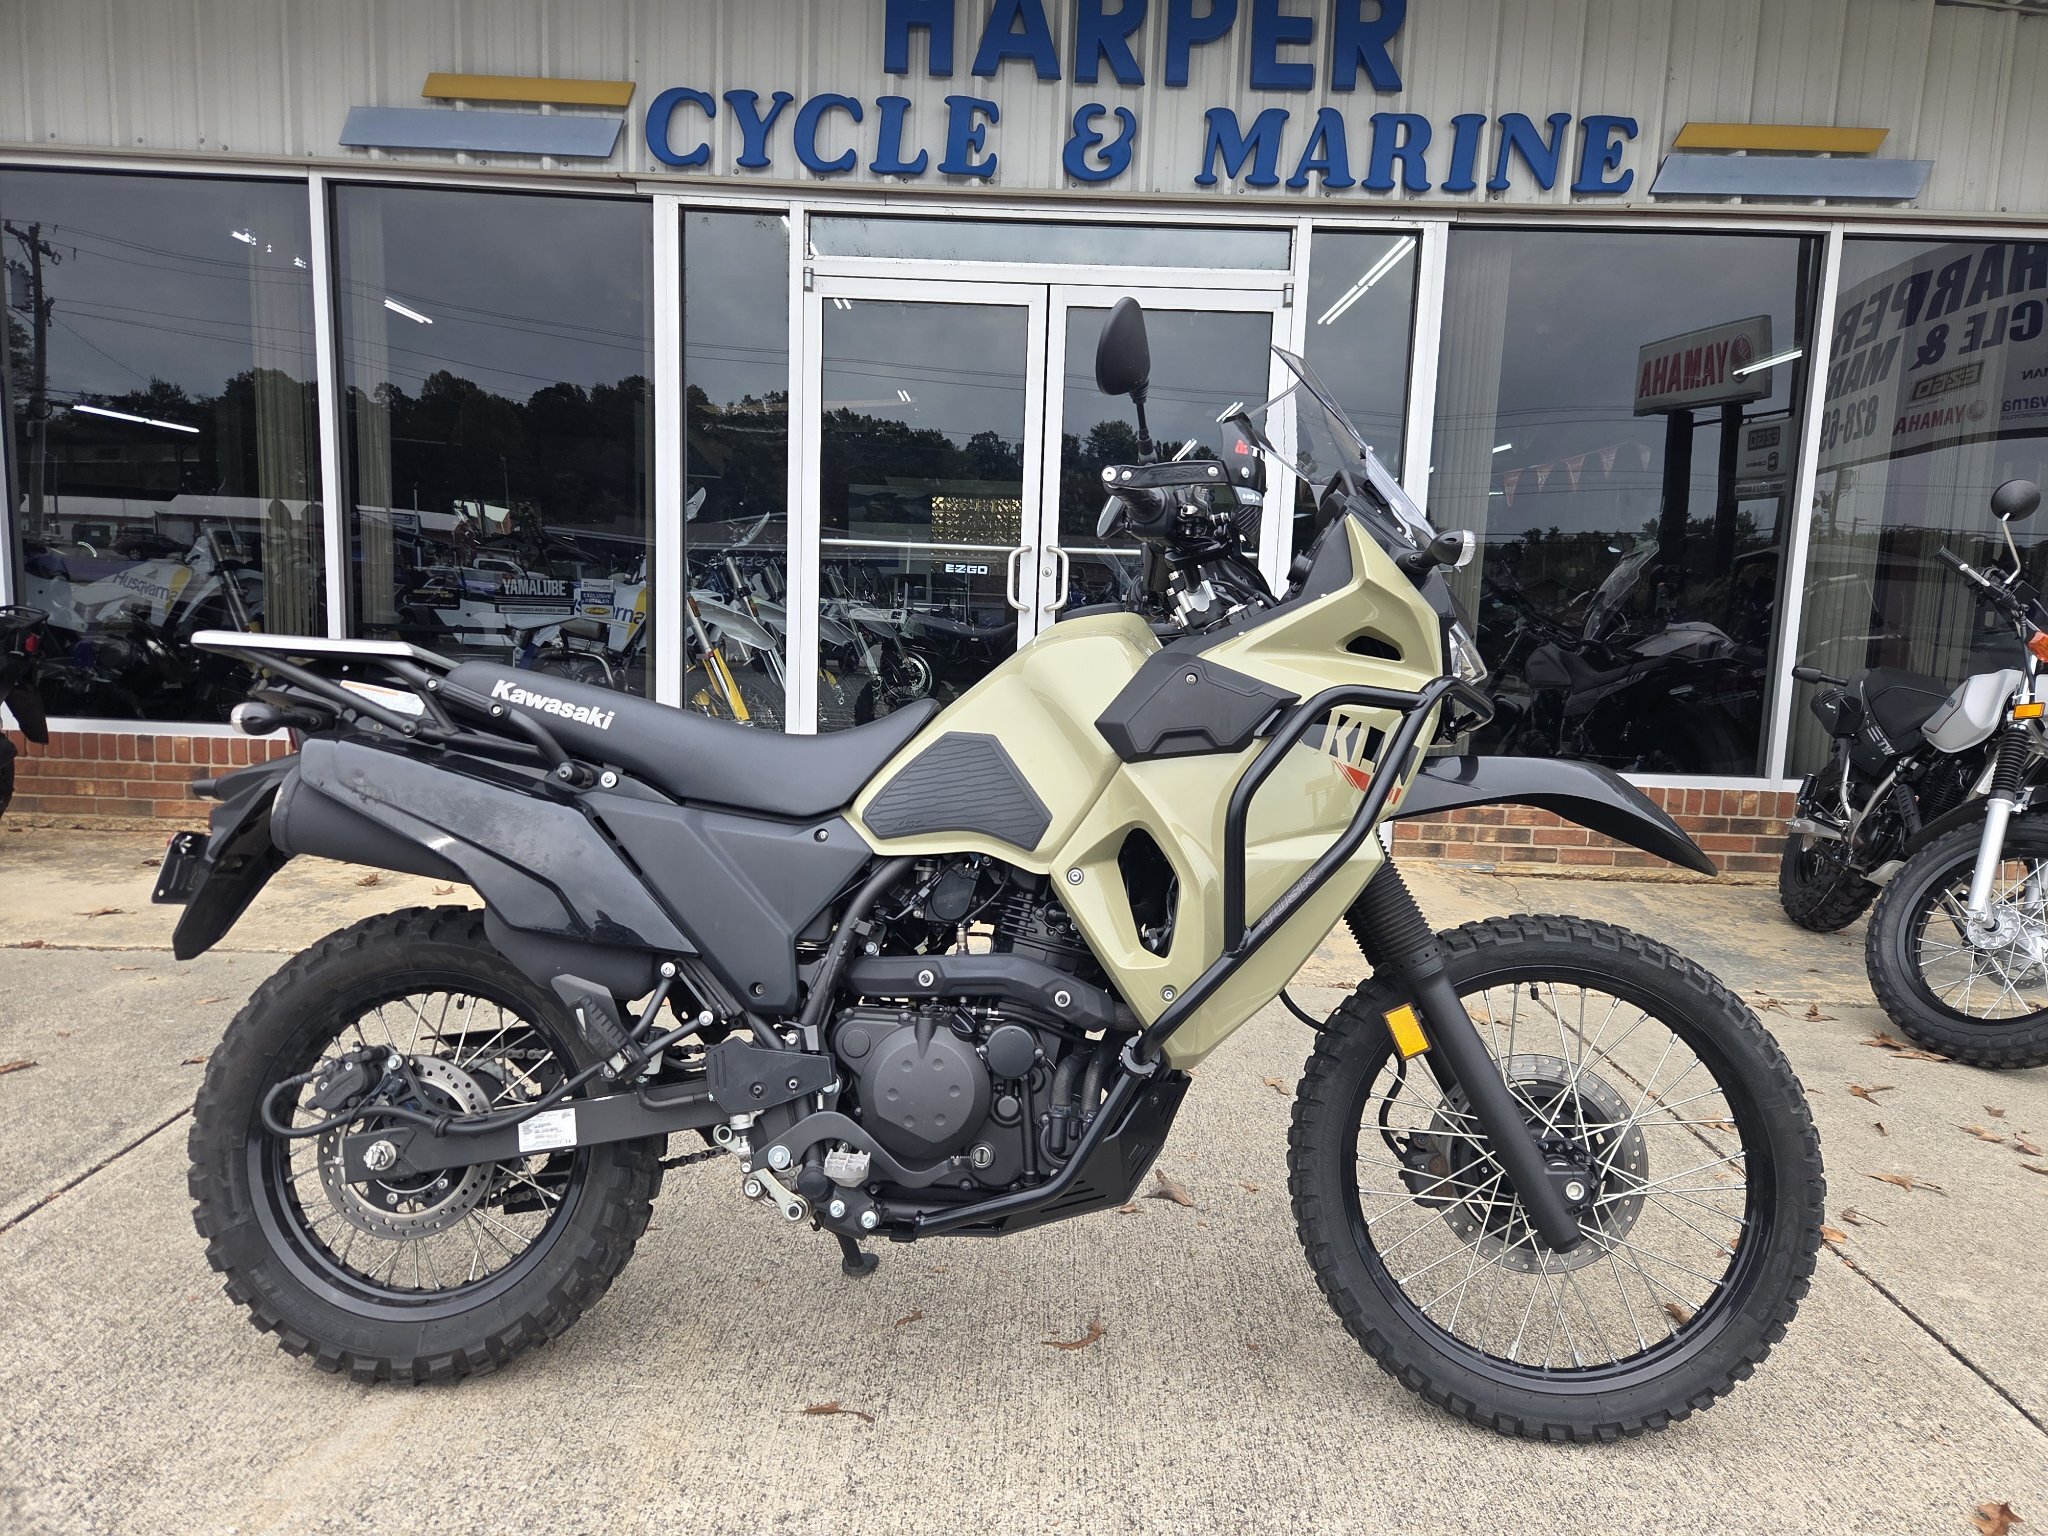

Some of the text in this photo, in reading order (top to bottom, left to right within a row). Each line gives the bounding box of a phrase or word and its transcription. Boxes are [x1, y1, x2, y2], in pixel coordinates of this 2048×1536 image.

[884, 0, 1405, 93] HARPER
[645, 86, 1639, 195] CYCLE & MARINE
[1148, 465, 1207, 483] TUSK
[112, 571, 178, 601] Husqvarna
[502, 578, 566, 596] YAMALUBE
[490, 680, 615, 730] Kawasaki
[1260, 868, 1318, 926] TUSK
